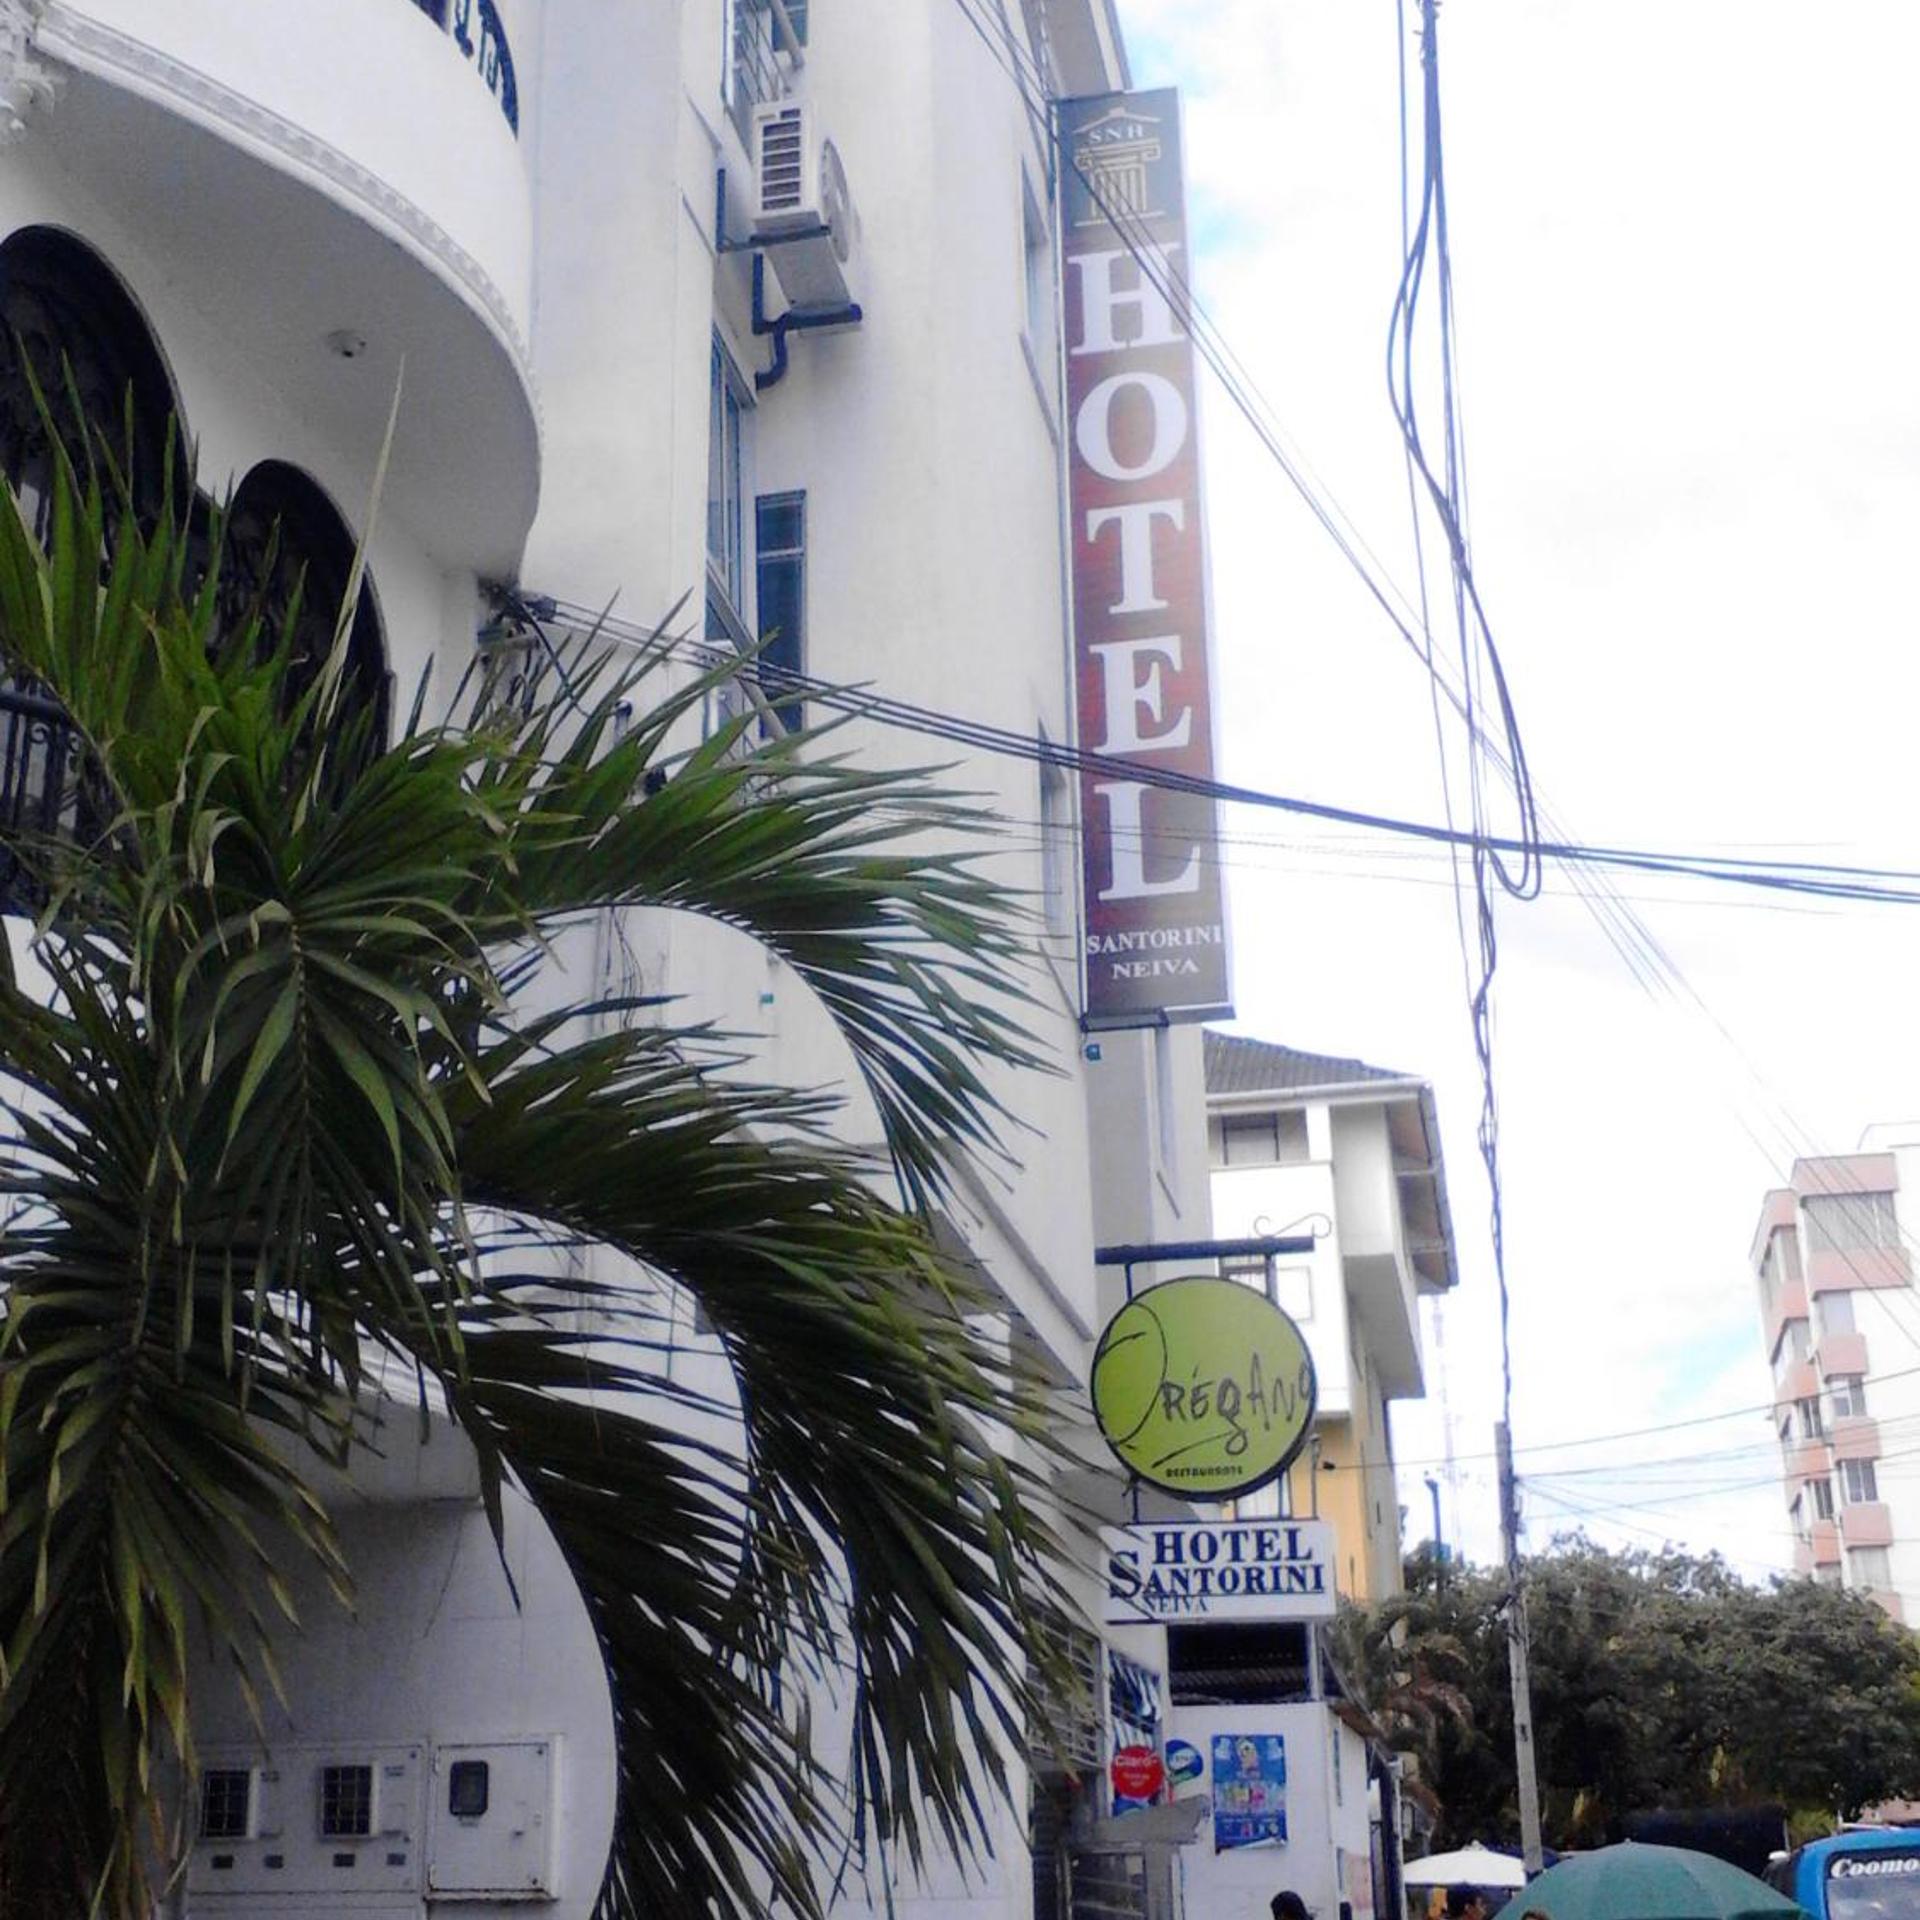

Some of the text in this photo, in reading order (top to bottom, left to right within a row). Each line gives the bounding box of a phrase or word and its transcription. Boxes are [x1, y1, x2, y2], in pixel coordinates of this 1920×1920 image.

[1067, 242, 1201, 901] HOTEL
[1086, 925, 1222, 955] SANTORINI
[1111, 957, 1200, 980] NEIVA
[1152, 1527, 1312, 1565] HOTEL
[1108, 1550, 1325, 1599] SANTORINI
[1143, 1596, 1209, 1614] NEIVA
